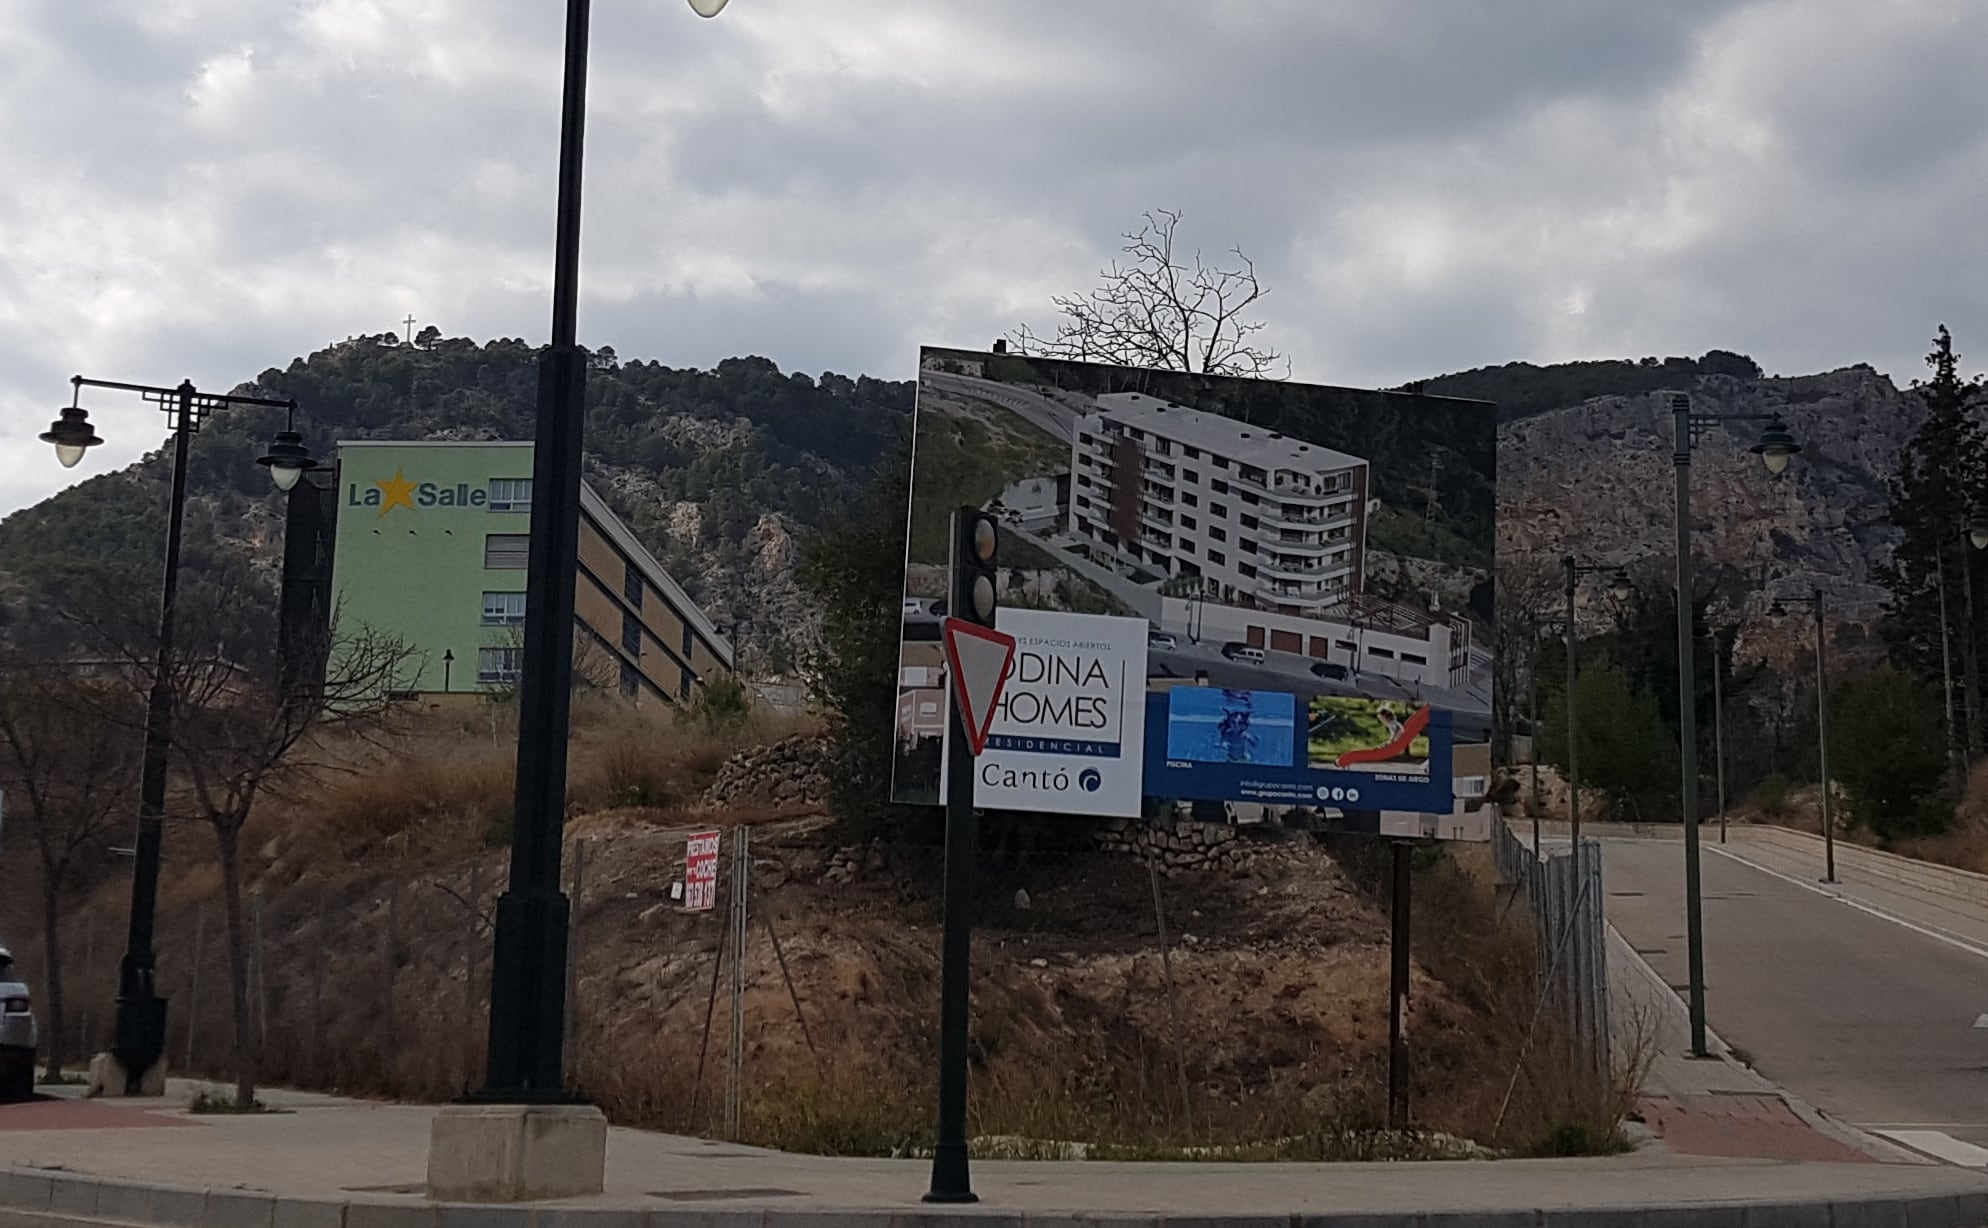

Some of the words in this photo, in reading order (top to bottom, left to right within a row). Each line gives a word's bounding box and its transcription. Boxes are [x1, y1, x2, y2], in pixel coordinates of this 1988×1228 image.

[348, 483, 381, 506] La
[417, 482, 487, 507] Salle
[1029, 637, 1071, 649] ESPACIOS
[1072, 640, 1111, 651] ABIERTOS
[981, 763, 1069, 792] Cantó
